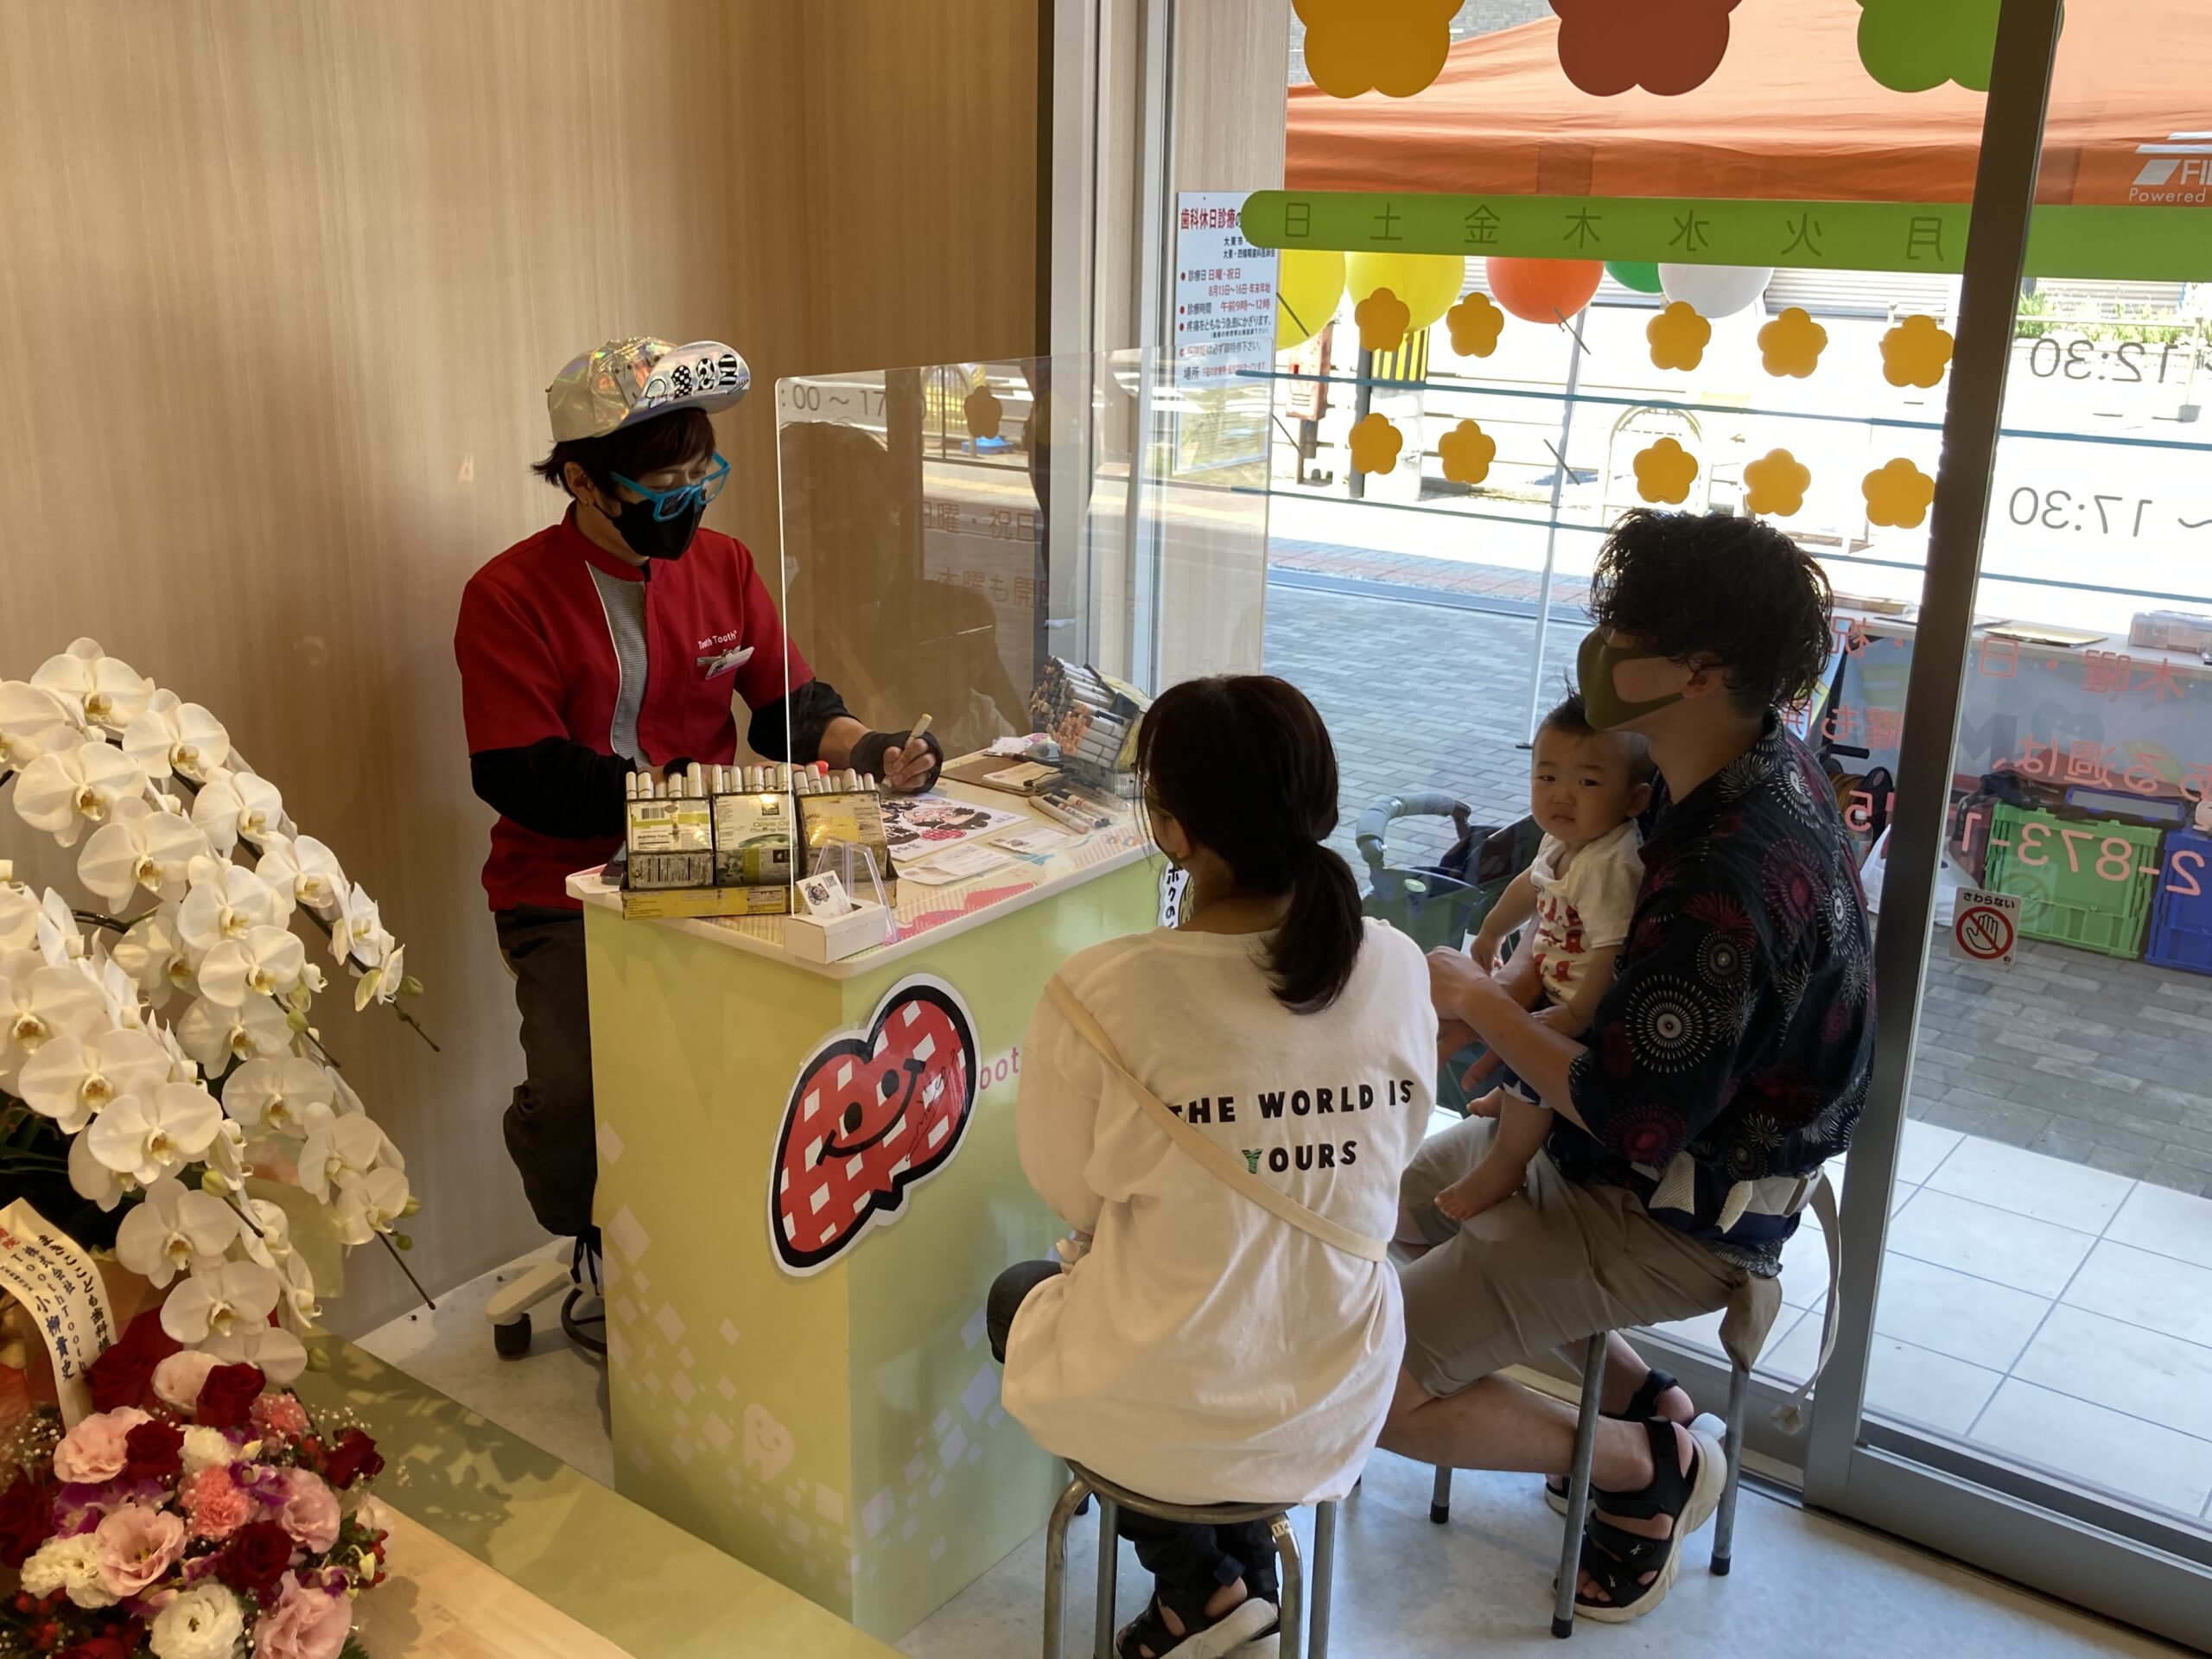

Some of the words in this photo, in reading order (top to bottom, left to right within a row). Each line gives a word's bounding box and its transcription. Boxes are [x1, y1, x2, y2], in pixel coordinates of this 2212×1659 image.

[2129, 187, 2206, 204] Powered
[1963, 892, 2015, 909] さわらない
[1258, 1084, 1374, 1118] WORLD
[1389, 1079, 1414, 1106] IS
[1242, 1141, 1357, 1174] YOURS
